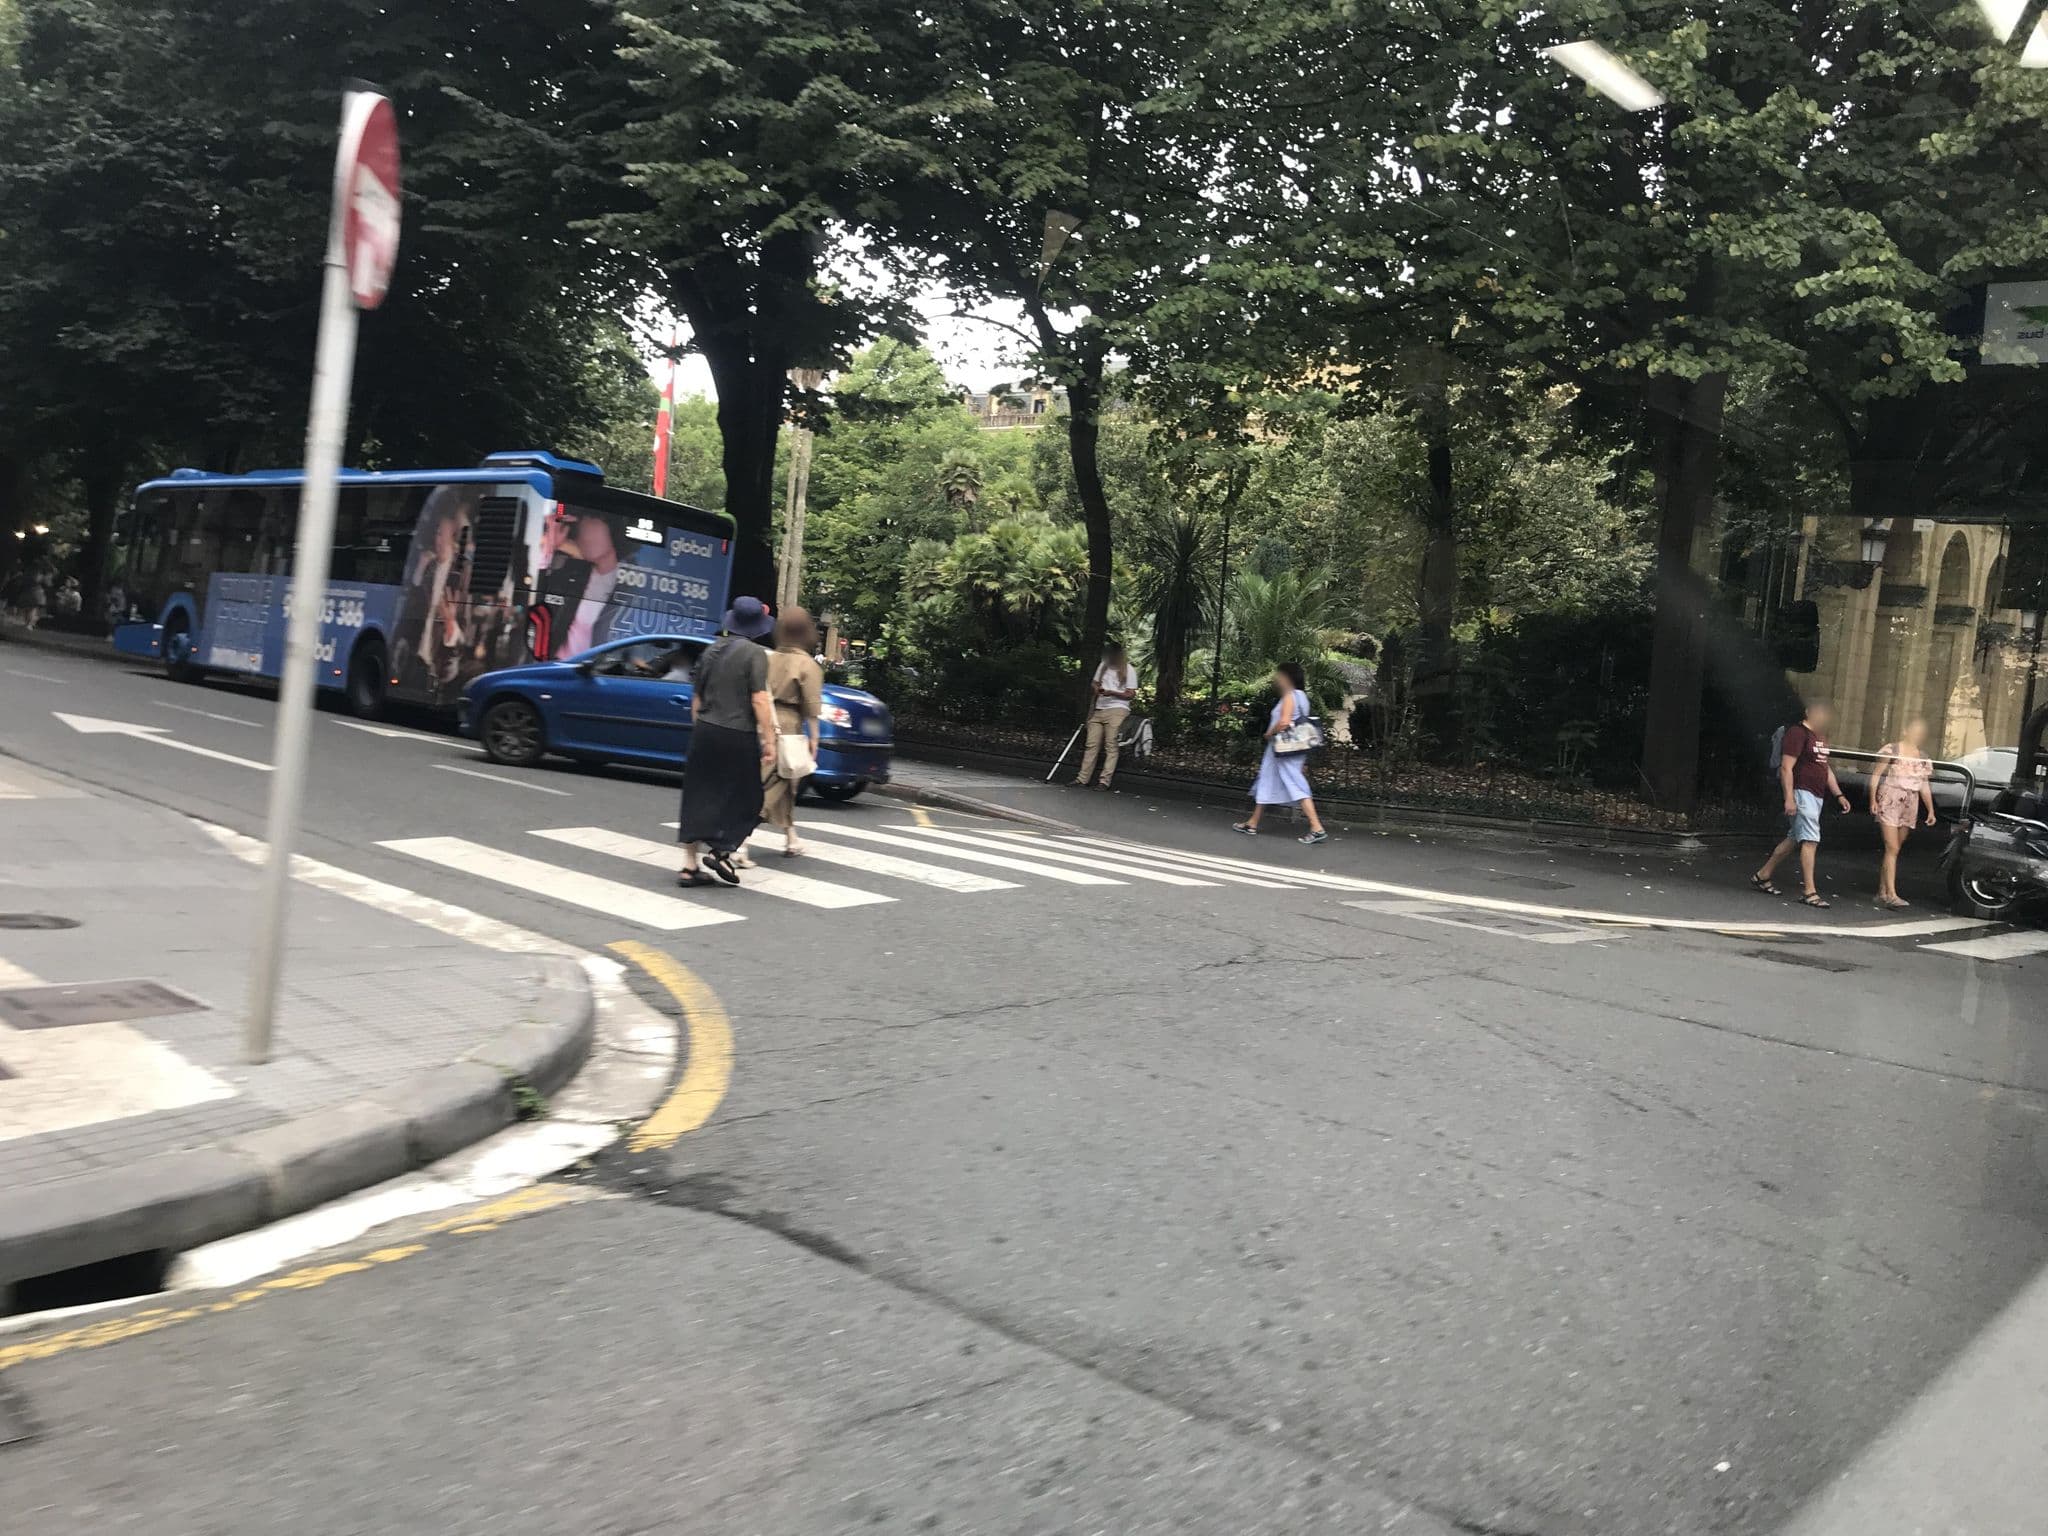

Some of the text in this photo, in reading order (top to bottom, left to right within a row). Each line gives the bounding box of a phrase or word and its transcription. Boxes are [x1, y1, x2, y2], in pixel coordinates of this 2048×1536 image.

[670, 537, 713, 558] global
[616, 569, 647, 588] 900
[650, 574, 679, 594] 103
[681, 581, 710, 601] 386
